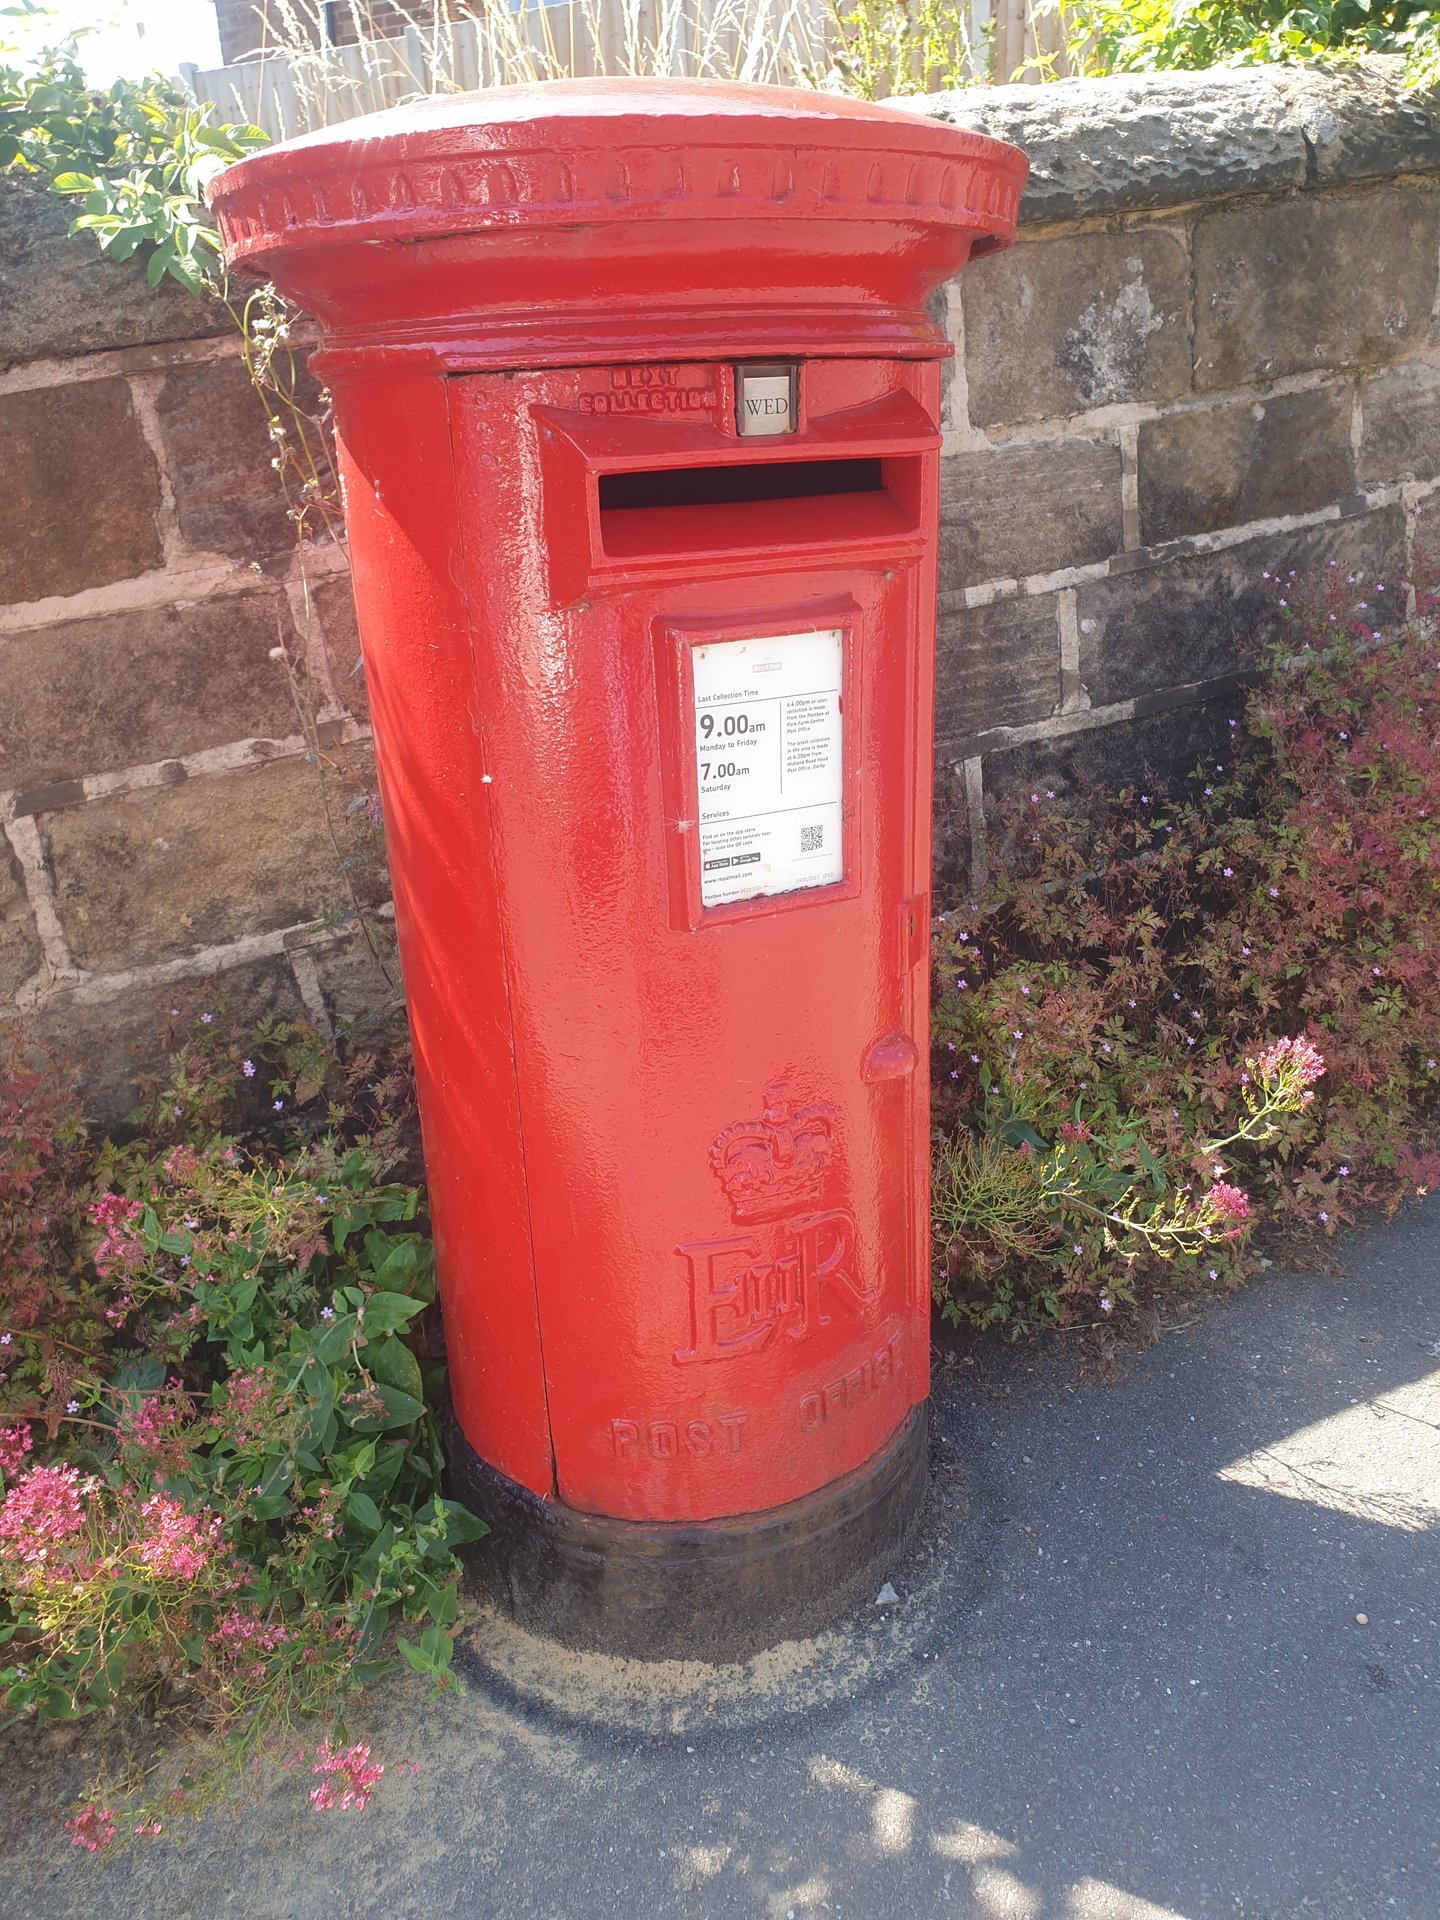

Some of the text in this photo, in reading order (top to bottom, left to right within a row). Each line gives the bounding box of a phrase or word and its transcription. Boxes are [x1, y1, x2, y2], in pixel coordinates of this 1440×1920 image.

[611, 366, 679, 389] NEXT
[578, 388, 716, 414] COLLECTION
[744, 398, 788, 415] WED
[713, 692, 742, 700] Collection
[700, 714, 765, 739] 9.00am
[700, 743, 726, 752] Monday
[701, 763, 749, 780] 7.00am
[701, 784, 731, 793] Saturday
[702, 811, 730, 819] Services
[704, 872, 752, 884] www.royalmail.com
[610, 1413, 749, 1460] POST
